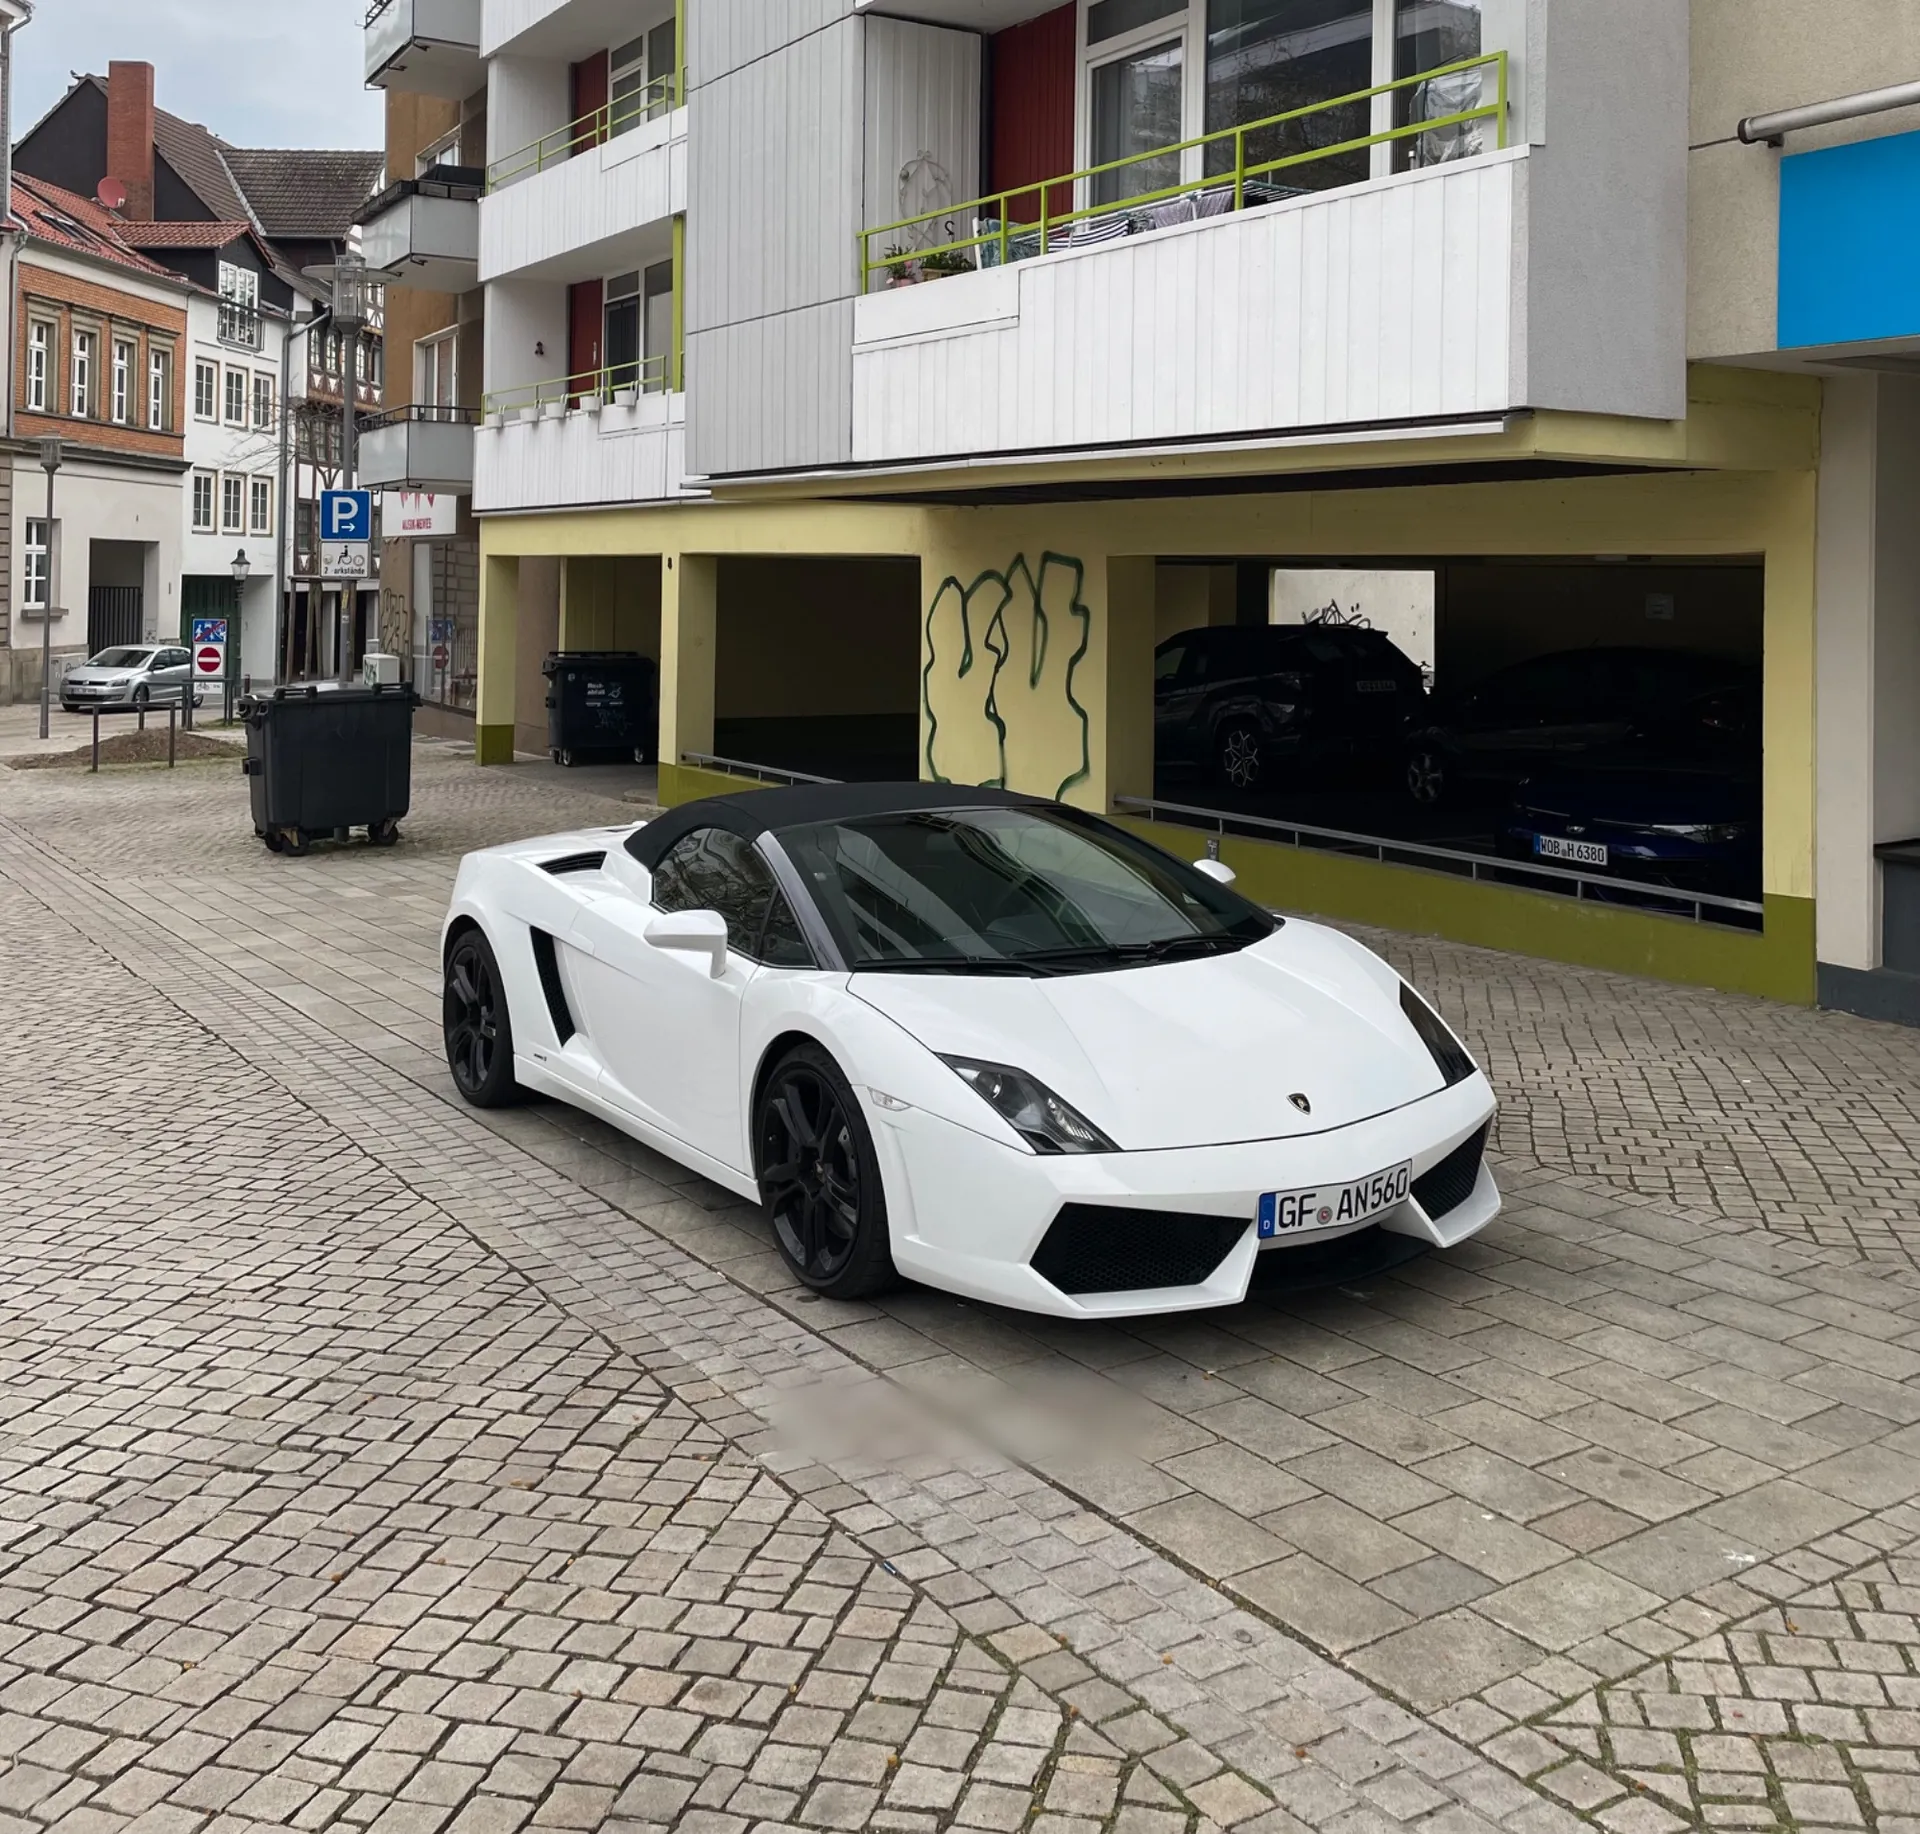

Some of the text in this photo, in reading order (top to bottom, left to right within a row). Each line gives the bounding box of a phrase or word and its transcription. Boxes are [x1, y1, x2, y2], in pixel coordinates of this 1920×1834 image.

[332, 496, 358, 533] P
[332, 566, 365, 574] arkstände
[1541, 838, 1560, 855] WOB
[1263, 1220, 1270, 1230] D
[1278, 1193, 1316, 1228] GF
